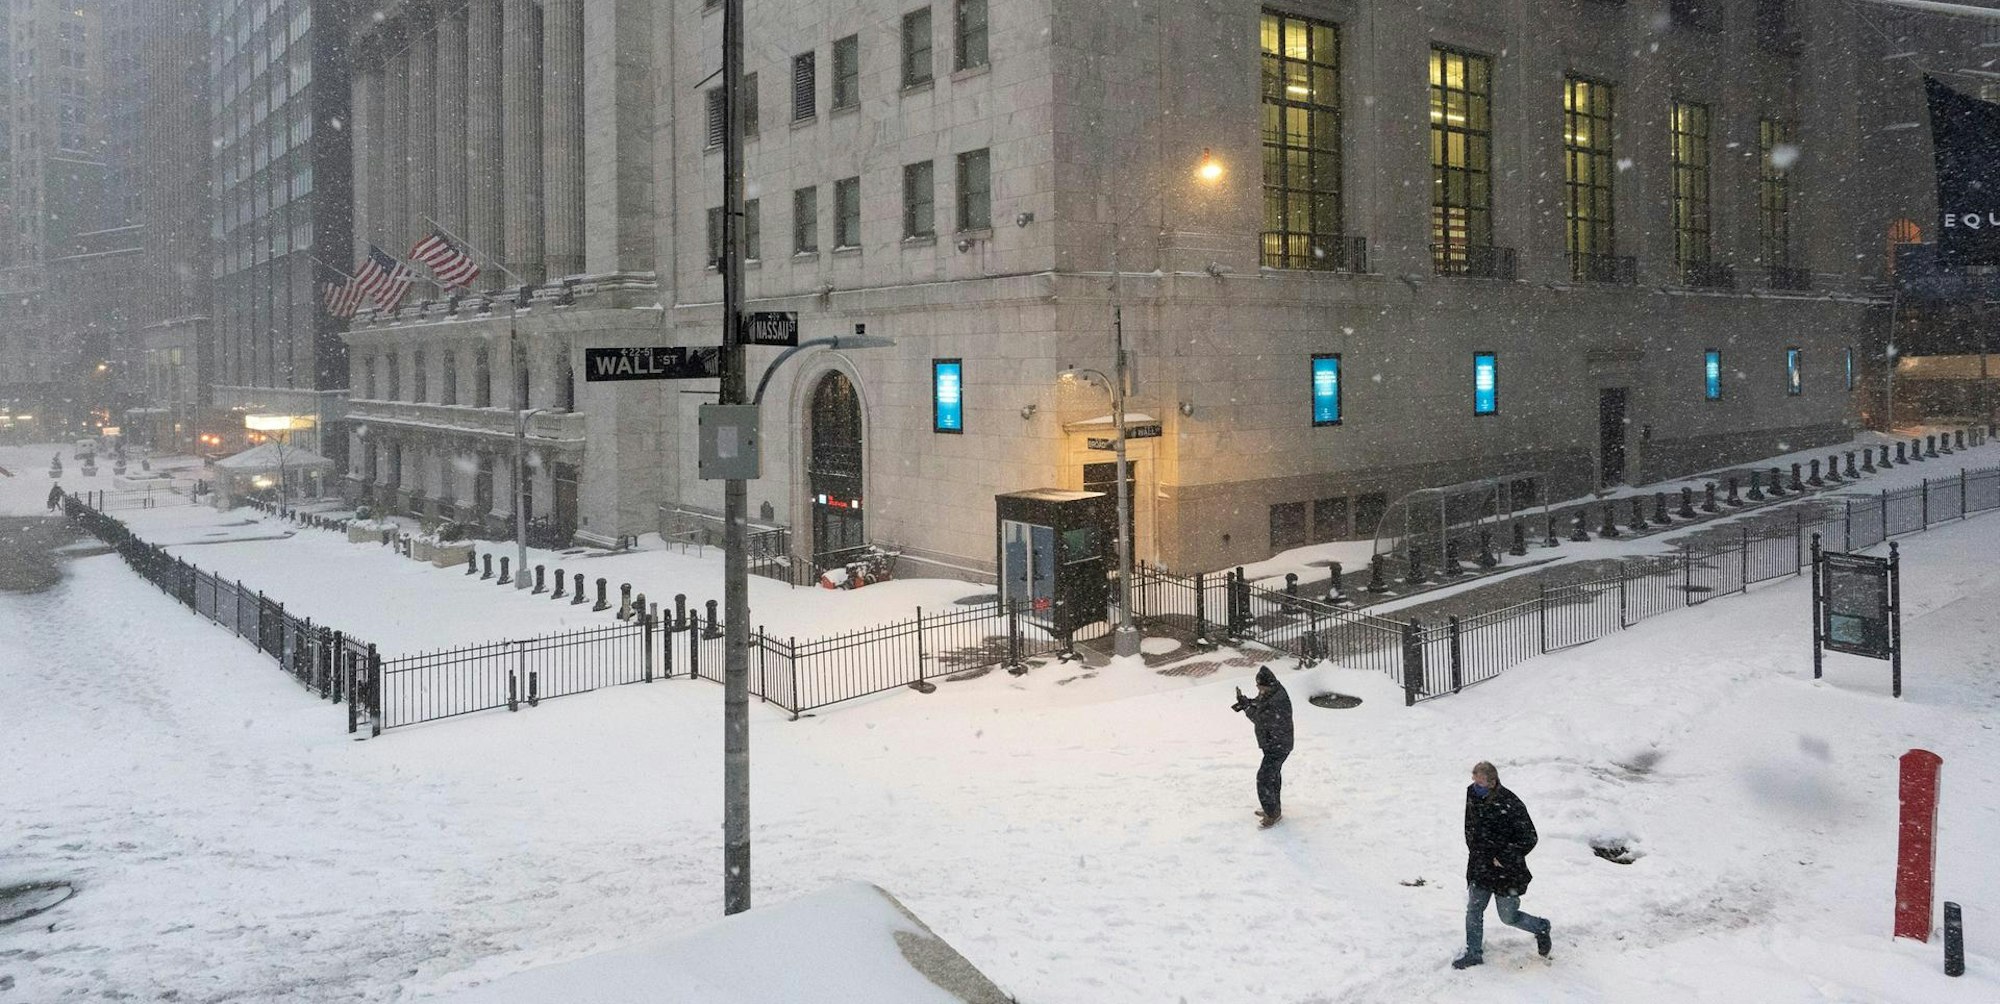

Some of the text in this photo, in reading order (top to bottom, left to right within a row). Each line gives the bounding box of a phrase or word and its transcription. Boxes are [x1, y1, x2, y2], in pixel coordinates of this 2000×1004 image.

[1945, 212, 2000, 229] EQU
[756, 320, 796, 340] NASSAU ST
[596, 355, 679, 375] WALL ST
[1138, 426, 1155, 436] WALL
